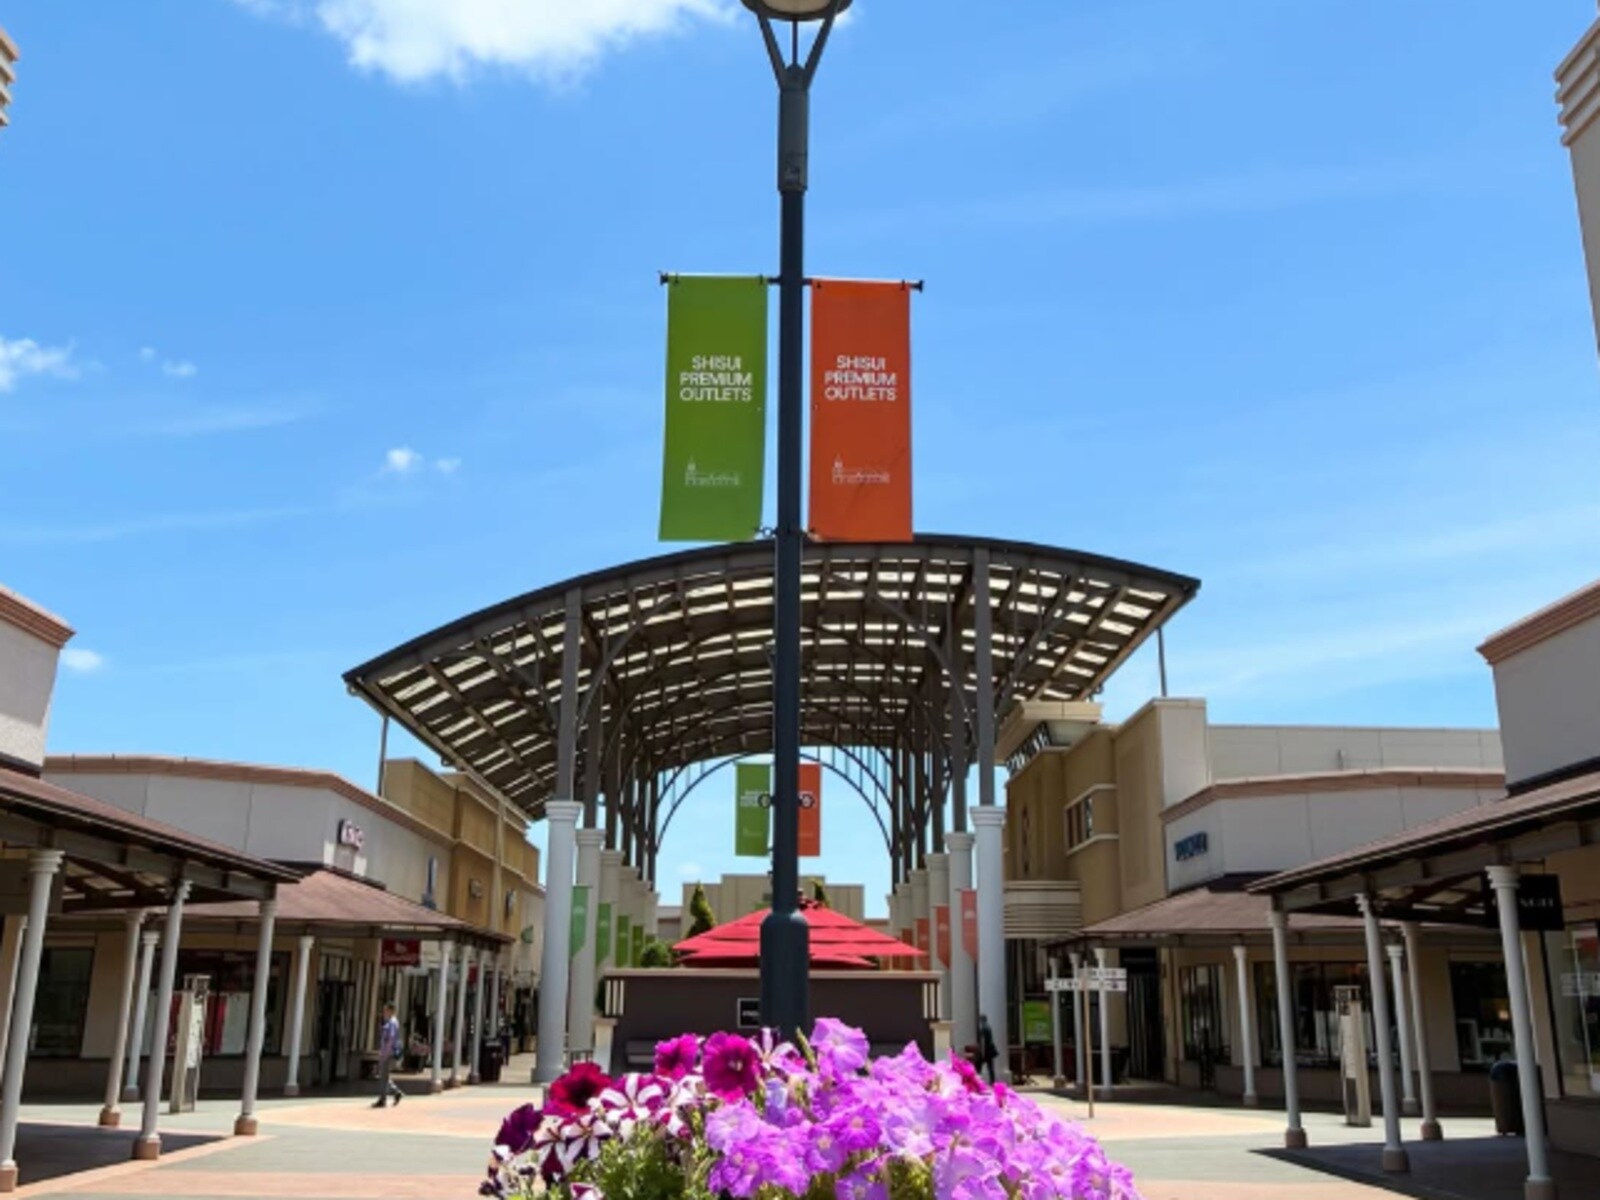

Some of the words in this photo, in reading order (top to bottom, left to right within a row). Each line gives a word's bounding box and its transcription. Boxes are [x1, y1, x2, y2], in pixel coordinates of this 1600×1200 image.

[692, 355, 741, 370] SHISUI
[836, 355, 886, 370] SHISUI
[680, 372, 752, 386] PREMIUM
[825, 371, 897, 386] PREMIUM
[680, 387, 752, 401] OUTLETS
[824, 387, 897, 401] OUTLETS
